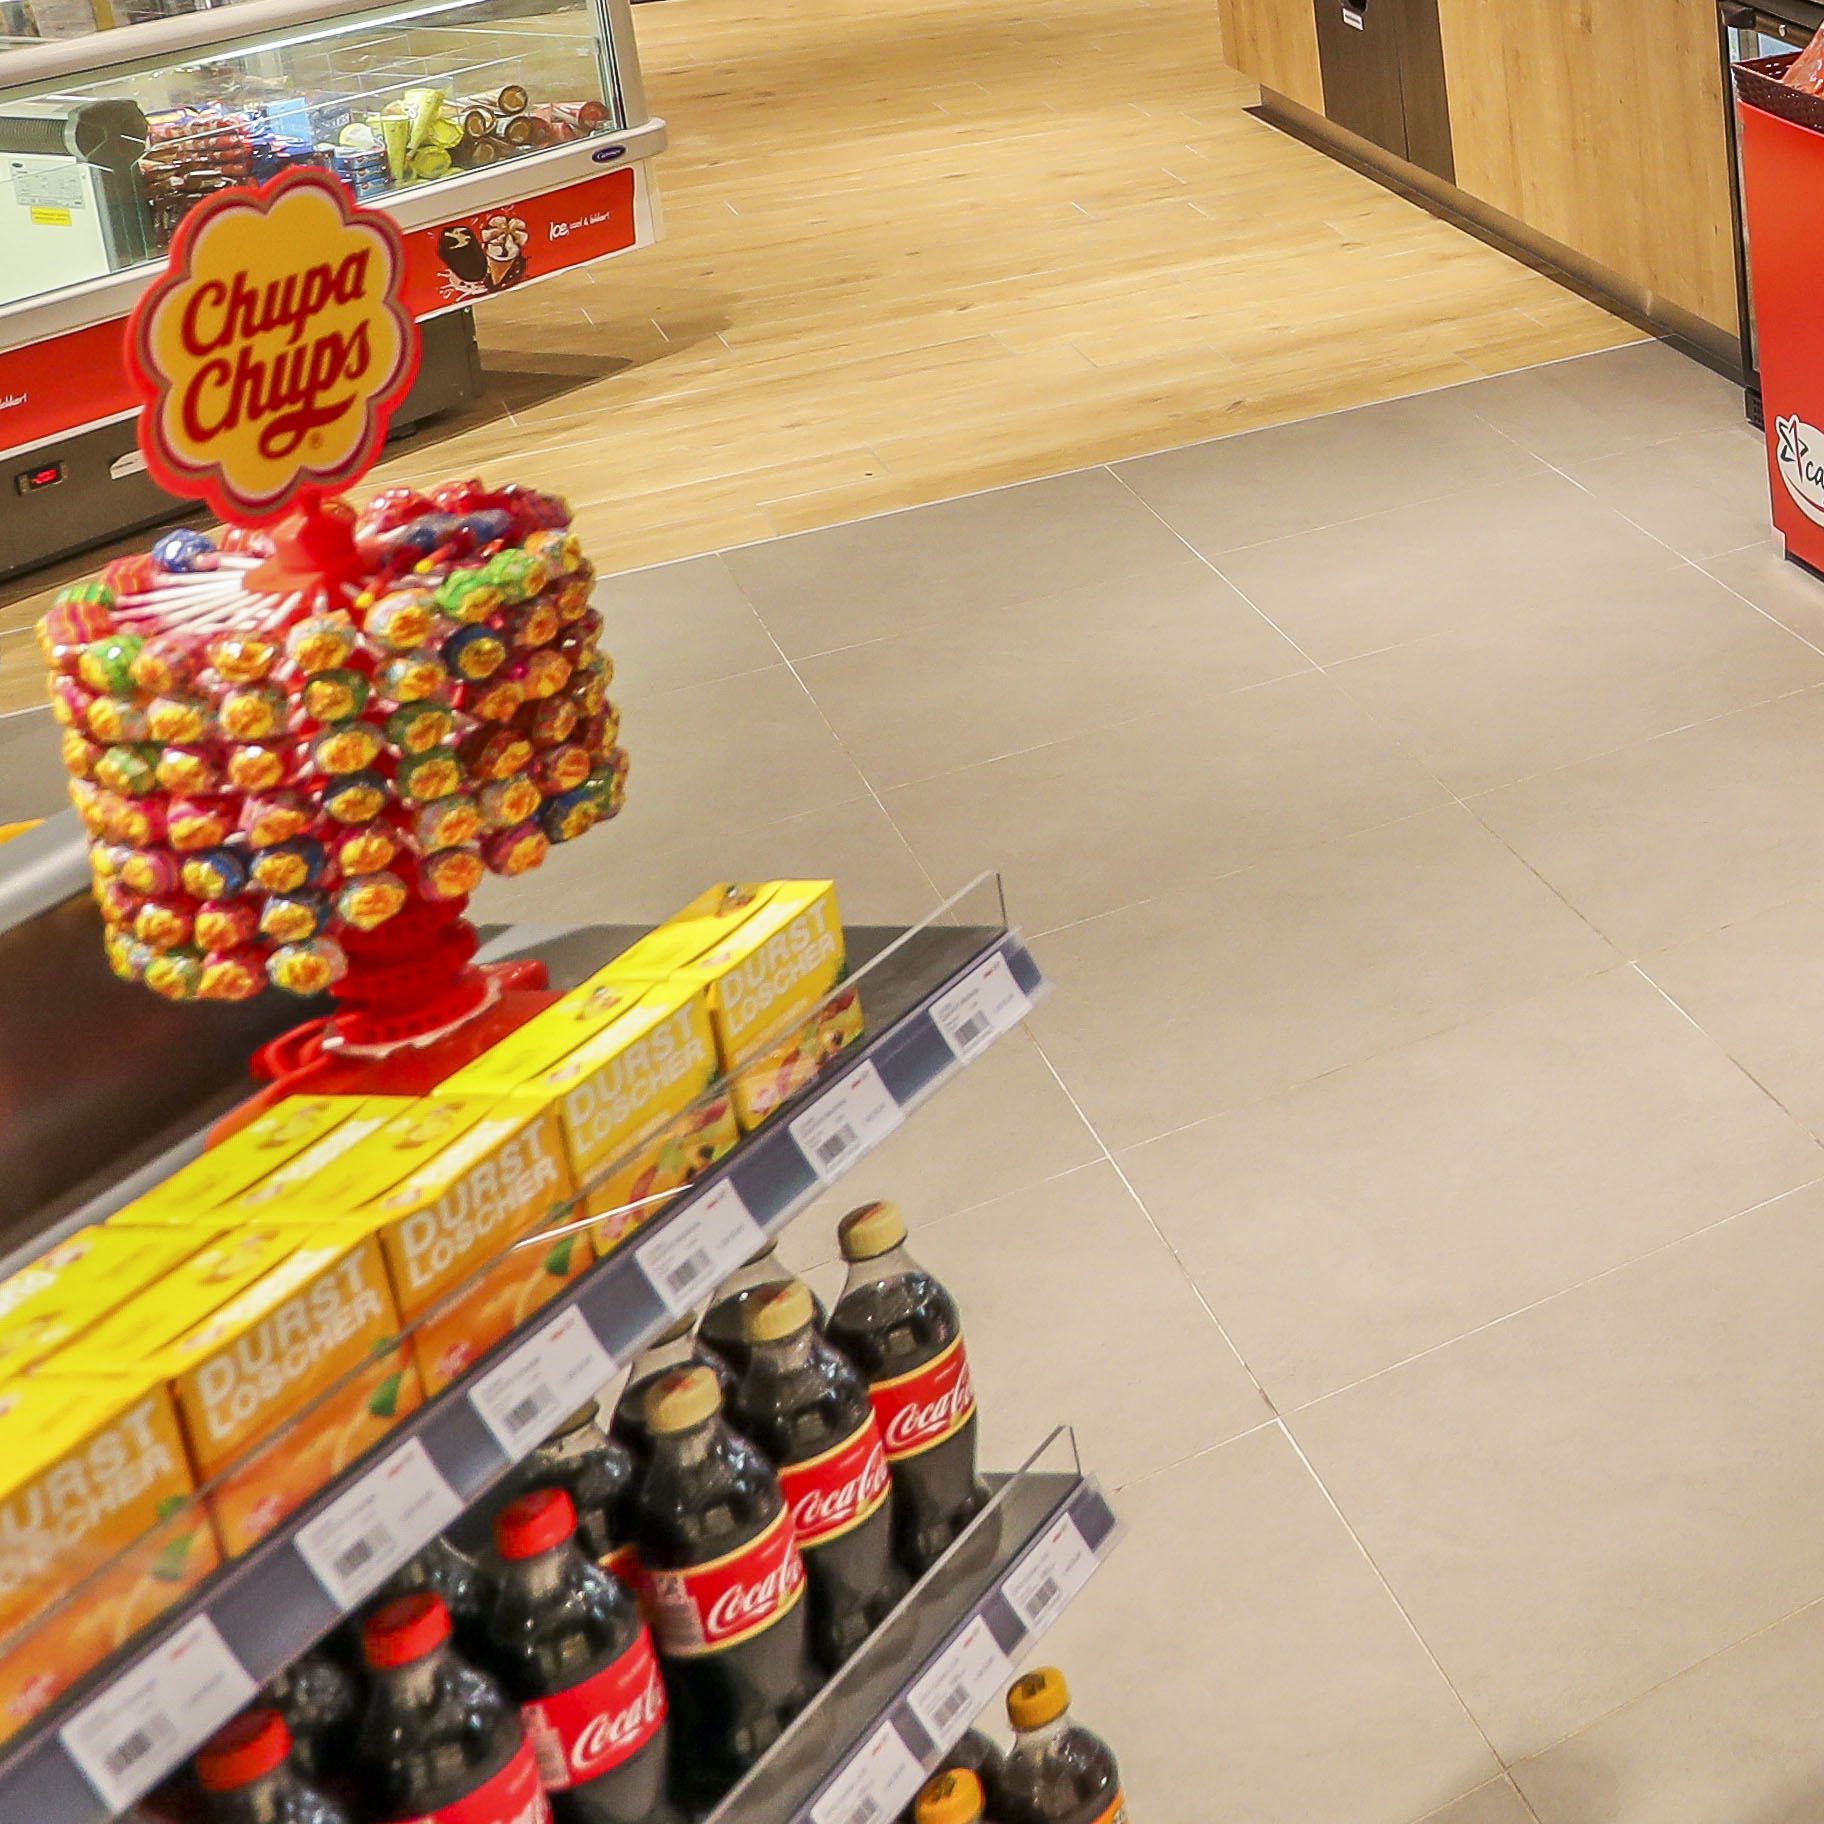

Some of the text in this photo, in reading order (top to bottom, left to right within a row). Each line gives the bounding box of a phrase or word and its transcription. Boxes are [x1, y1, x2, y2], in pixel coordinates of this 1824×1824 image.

[181, 246, 373, 360] Chupa
[181, 317, 373, 462] Chups
[716, 894, 831, 1005] DURST
